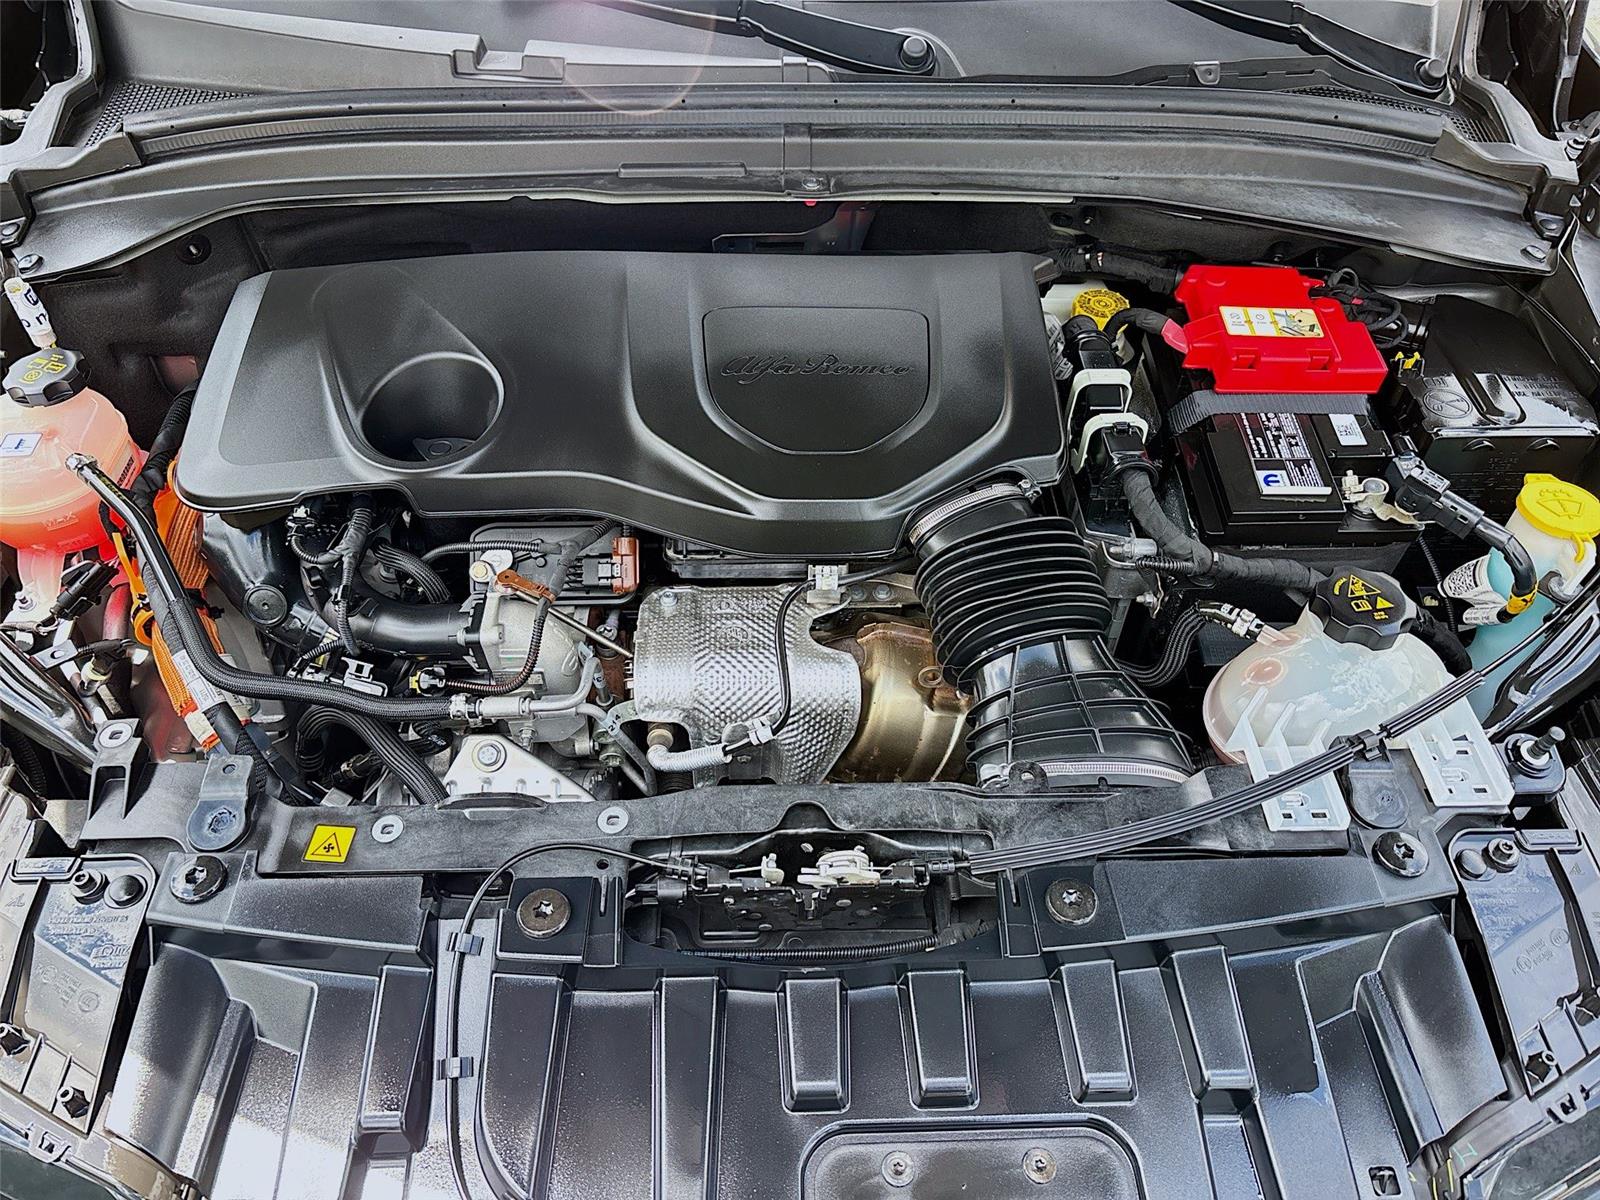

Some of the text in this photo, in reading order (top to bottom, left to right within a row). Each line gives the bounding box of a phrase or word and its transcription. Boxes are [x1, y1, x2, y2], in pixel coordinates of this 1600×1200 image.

[720, 353, 912, 385] Alfa Romeo
[608, 714, 622, 732] 214
